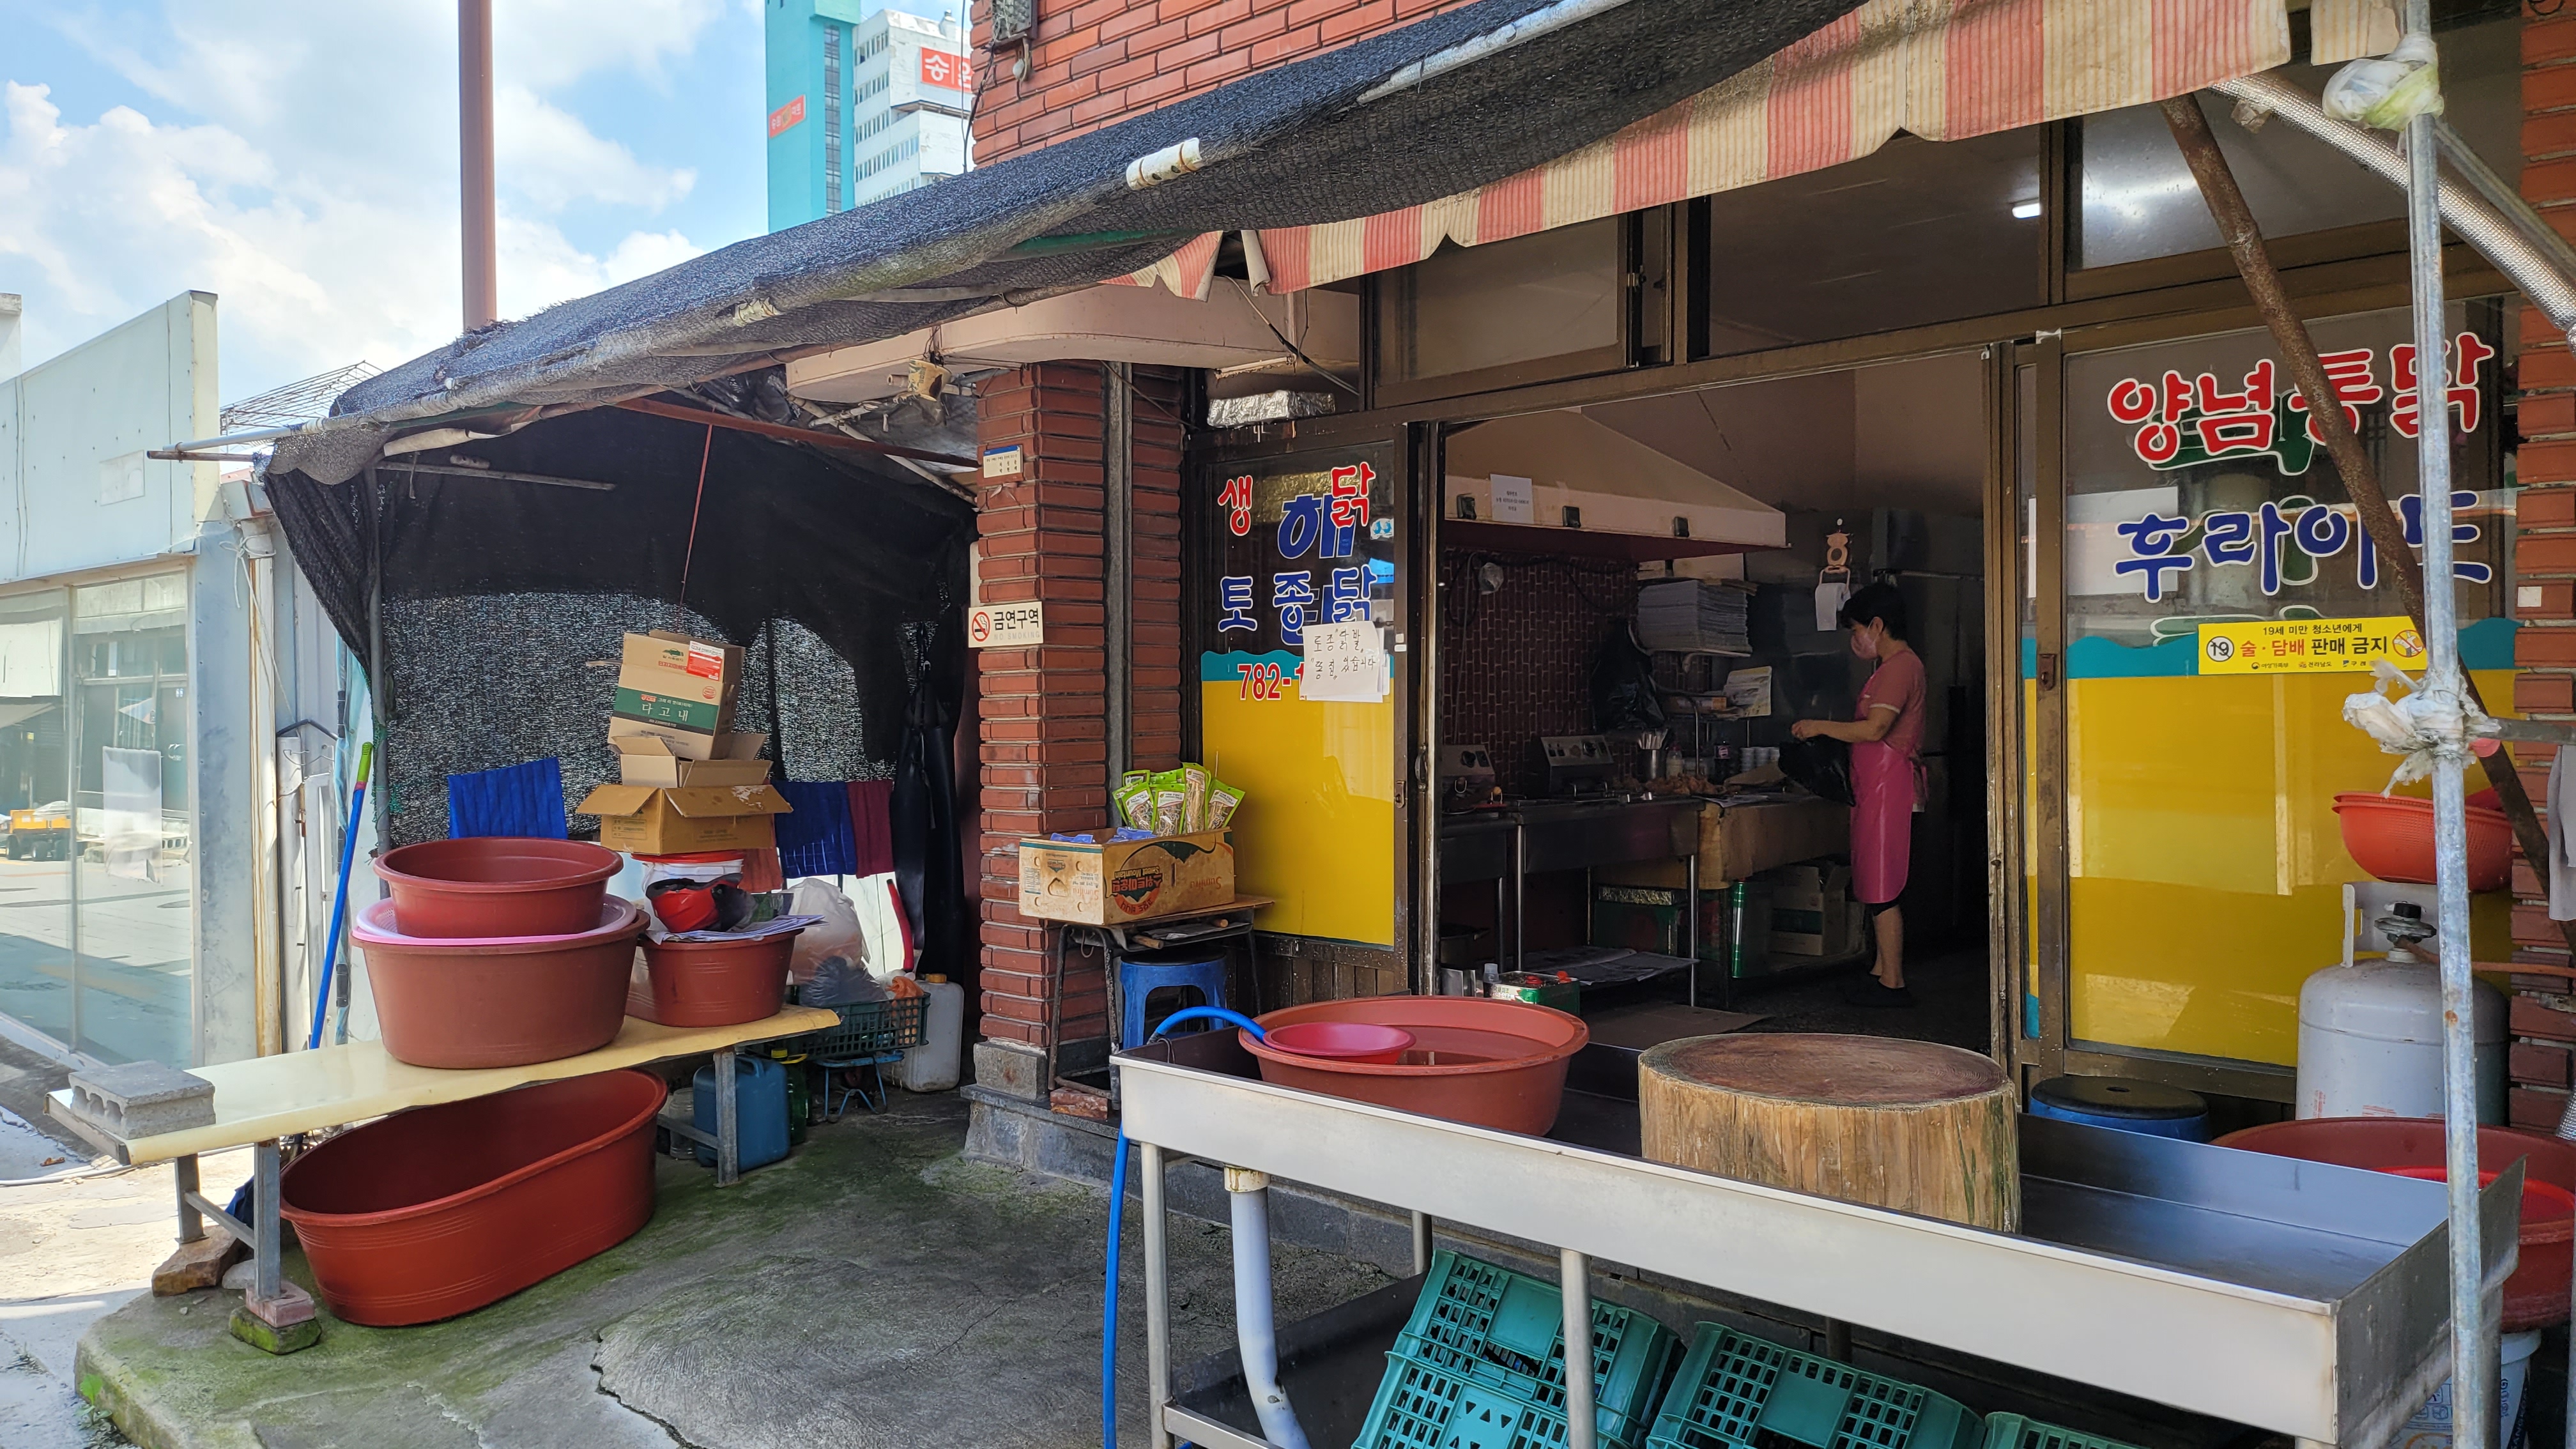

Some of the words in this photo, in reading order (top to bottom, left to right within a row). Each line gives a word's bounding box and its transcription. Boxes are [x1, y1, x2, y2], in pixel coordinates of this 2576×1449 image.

[993, 608, 1039, 631] 금연구역
[1008, 631, 1040, 640] SMOKING
[2263, 626, 2284, 636] 19세
[2288, 625, 2308, 635] 미만
[2312, 623, 2363, 634] 청소년에게
[2310, 637, 2345, 656] 판매
[2350, 636, 2387, 655] 금지
[1340, 656, 1376, 672] 있습니다
[1114, 868, 1142, 879] Mountain
[1190, 877, 1222, 890] Sumifru
